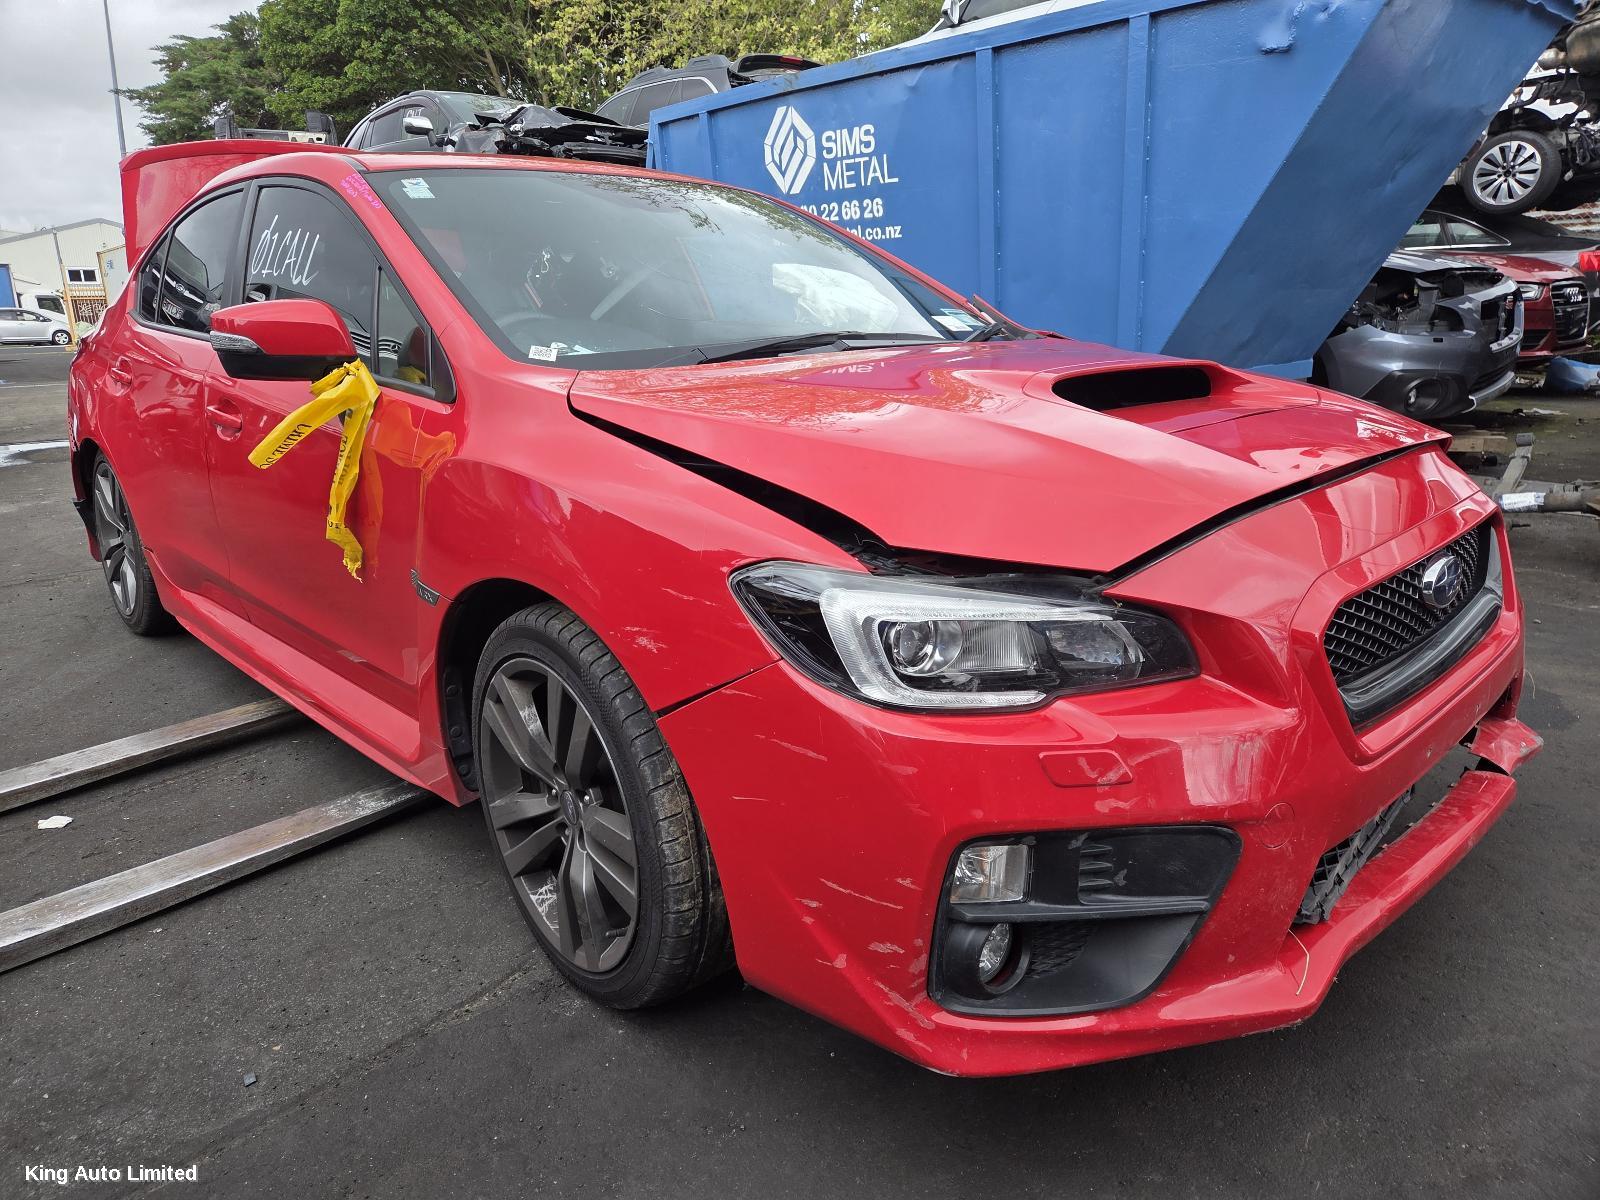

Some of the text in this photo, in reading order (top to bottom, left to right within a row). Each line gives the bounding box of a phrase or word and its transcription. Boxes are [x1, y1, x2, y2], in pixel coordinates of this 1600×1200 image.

[821, 124, 875, 159] SIMS
[823, 154, 899, 191] METAL
[821, 202, 840, 221] 22
[842, 200, 861, 220] 66
[863, 198, 884, 218] 26
